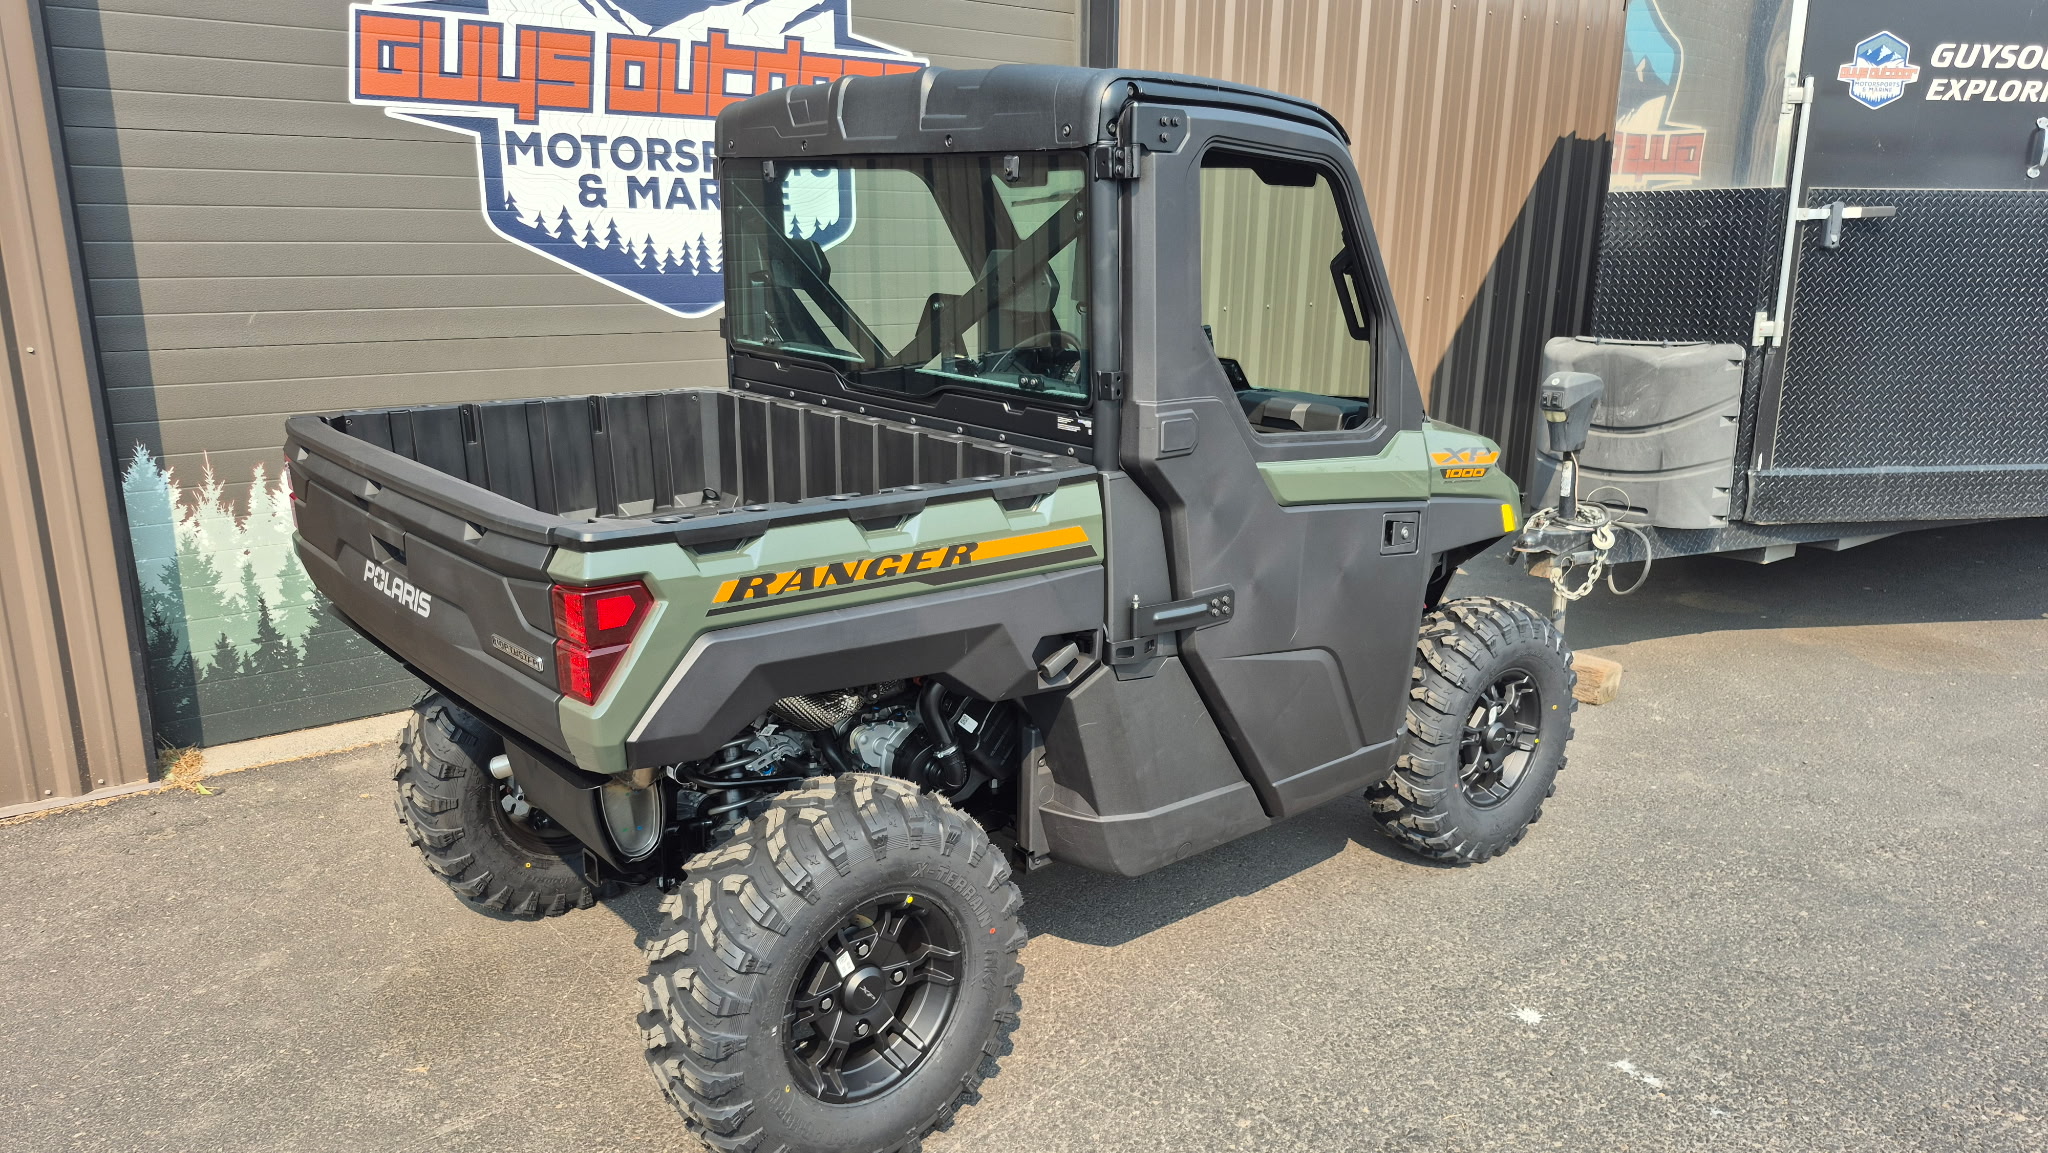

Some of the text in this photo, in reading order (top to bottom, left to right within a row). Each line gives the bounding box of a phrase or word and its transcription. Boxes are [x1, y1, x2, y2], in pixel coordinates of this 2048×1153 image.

[578, 174, 607, 208] &
[1440, 447, 1492, 463] XP
[1445, 468, 1486, 478] 1000
[363, 559, 432, 618] POLARIS
[727, 541, 979, 603] RANGER
